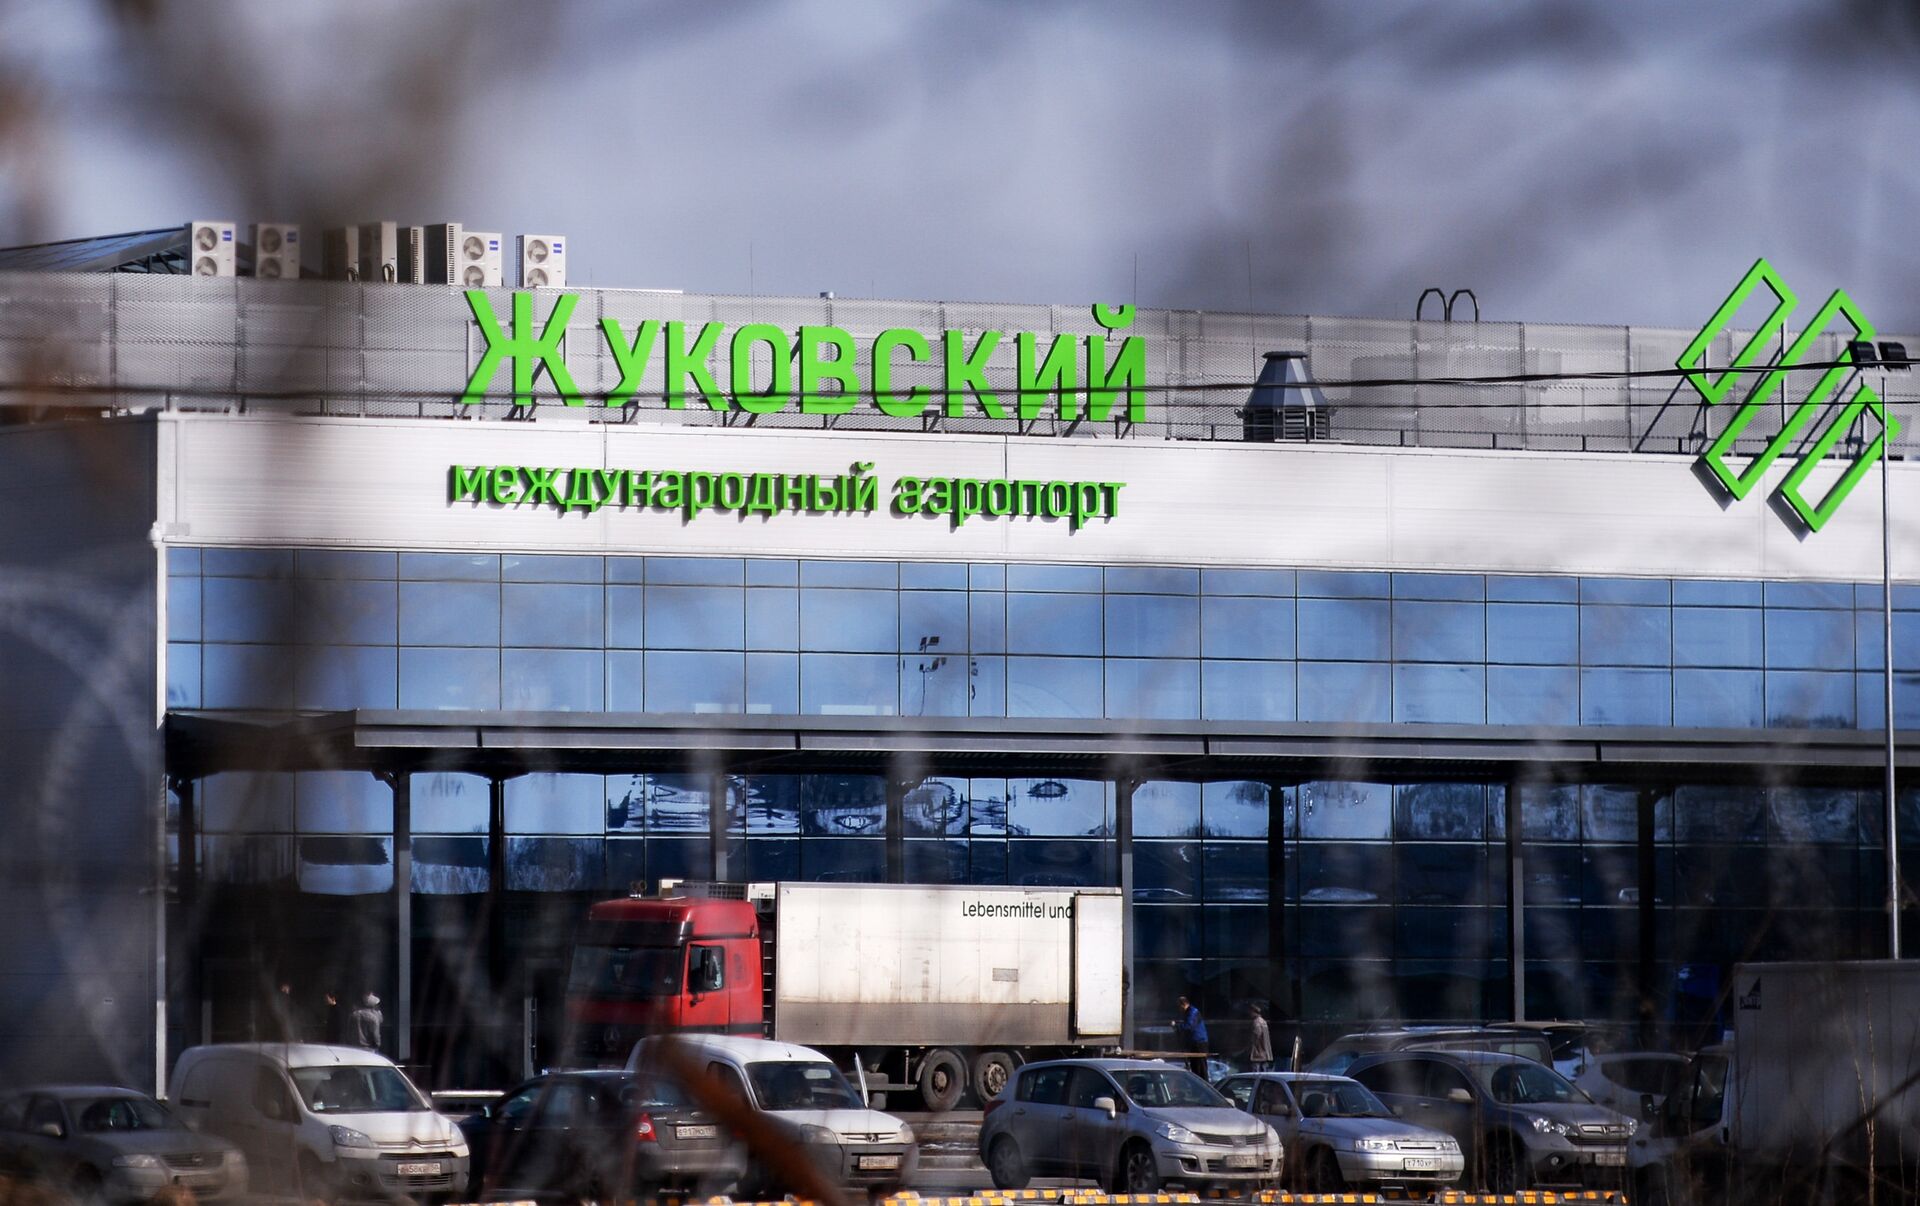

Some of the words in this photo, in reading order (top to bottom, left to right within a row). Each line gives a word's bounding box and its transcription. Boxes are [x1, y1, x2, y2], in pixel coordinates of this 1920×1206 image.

[450, 462, 880, 520] международный
[896, 475, 1126, 529] аэропорт
[962, 900, 1046, 919] Lebensmittel
